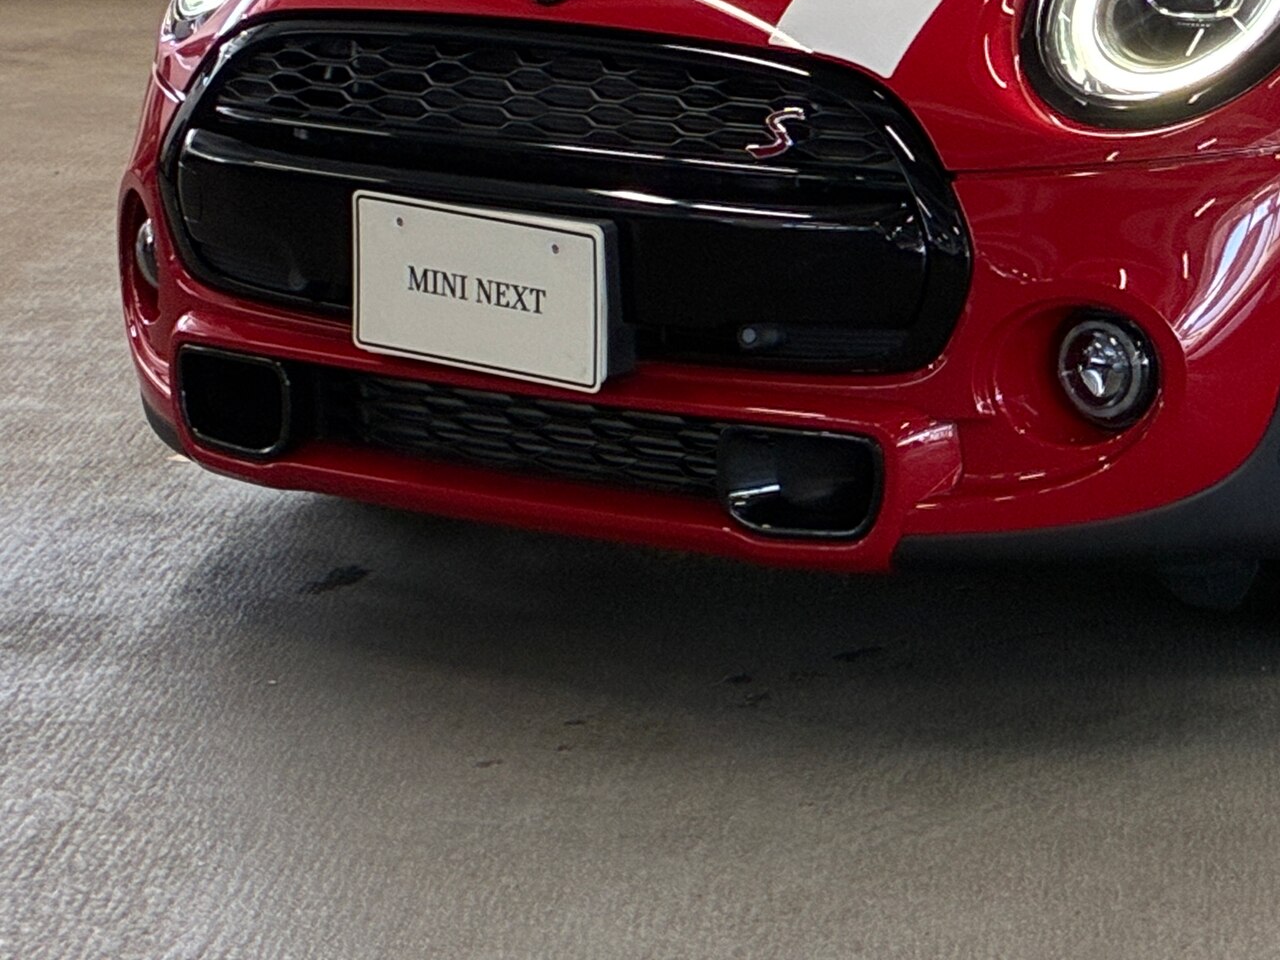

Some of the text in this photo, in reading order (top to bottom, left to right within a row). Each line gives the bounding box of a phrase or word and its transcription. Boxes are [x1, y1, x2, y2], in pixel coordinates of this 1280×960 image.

[745, 107, 805, 159] S
[408, 265, 546, 314] MINI NEXT
